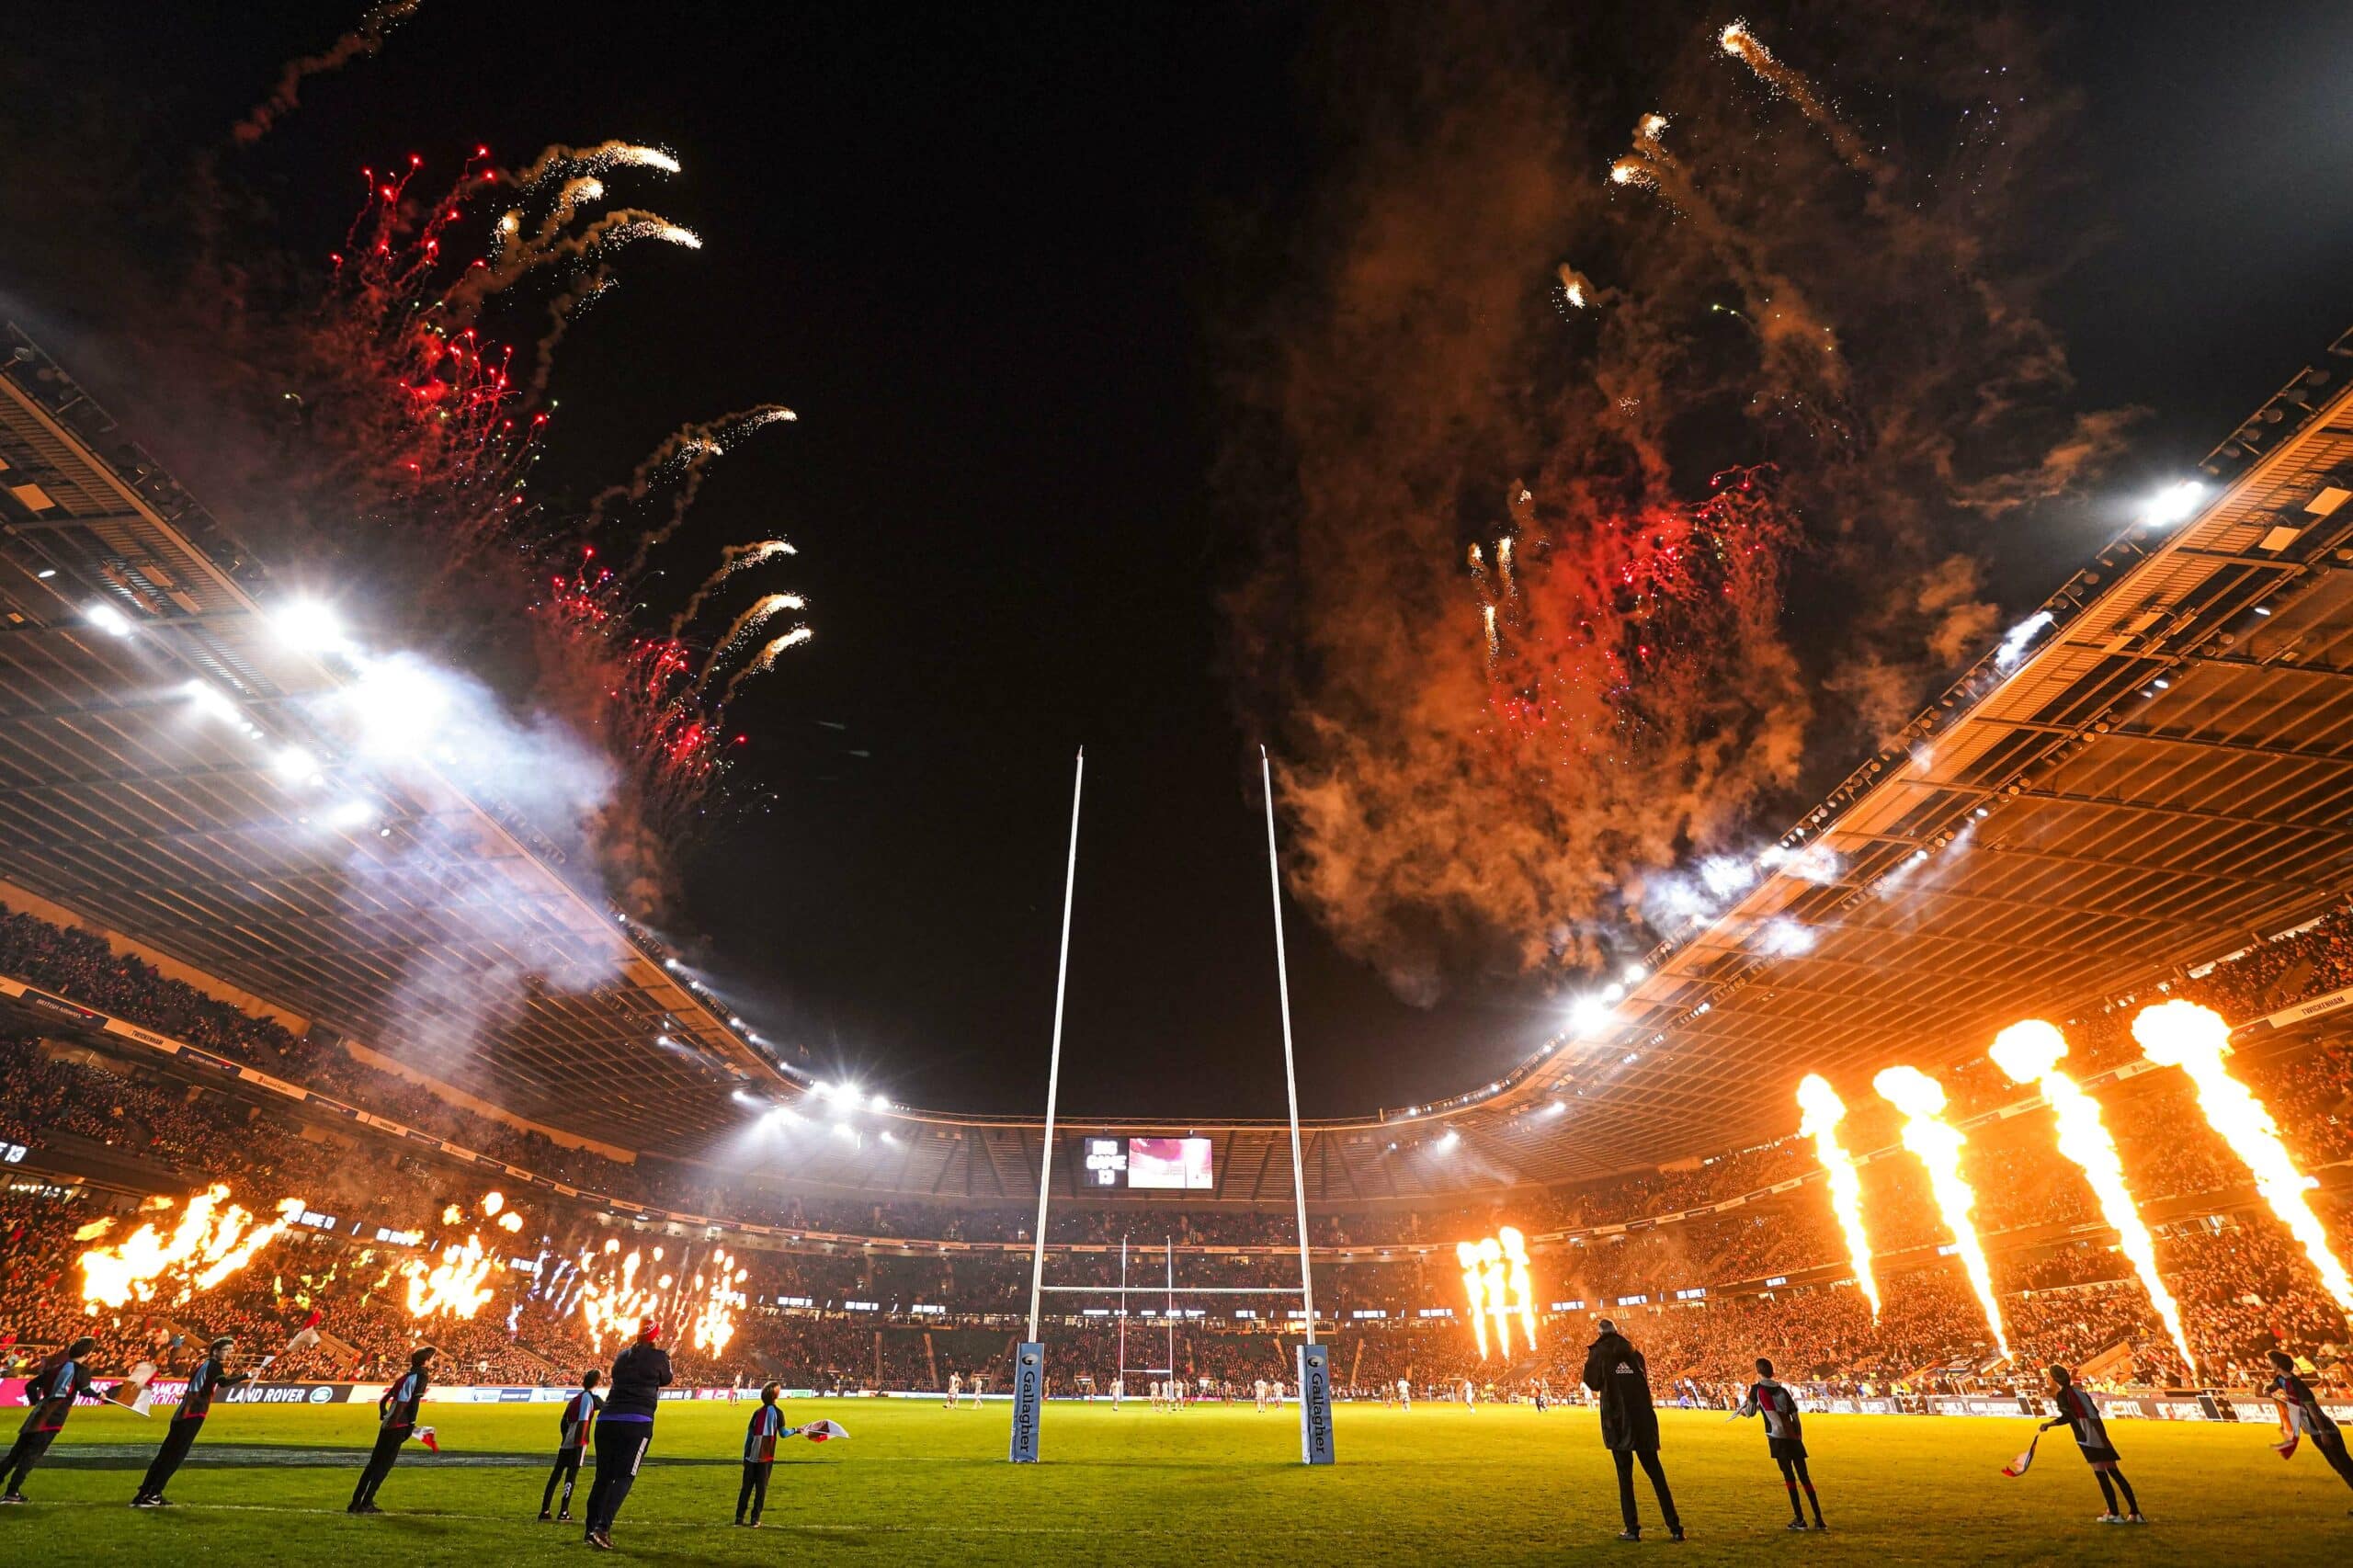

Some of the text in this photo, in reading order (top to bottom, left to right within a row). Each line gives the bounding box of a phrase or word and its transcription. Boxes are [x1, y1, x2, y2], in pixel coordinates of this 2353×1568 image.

[2302, 996, 2346, 1016] TWICKENHAM
[225, 1388, 264, 1403] LAND
[263, 1388, 306, 1403] ROVER
[1019, 1370, 1035, 1452] Gallagher
[1312, 1372, 1325, 1454] Gallagher
